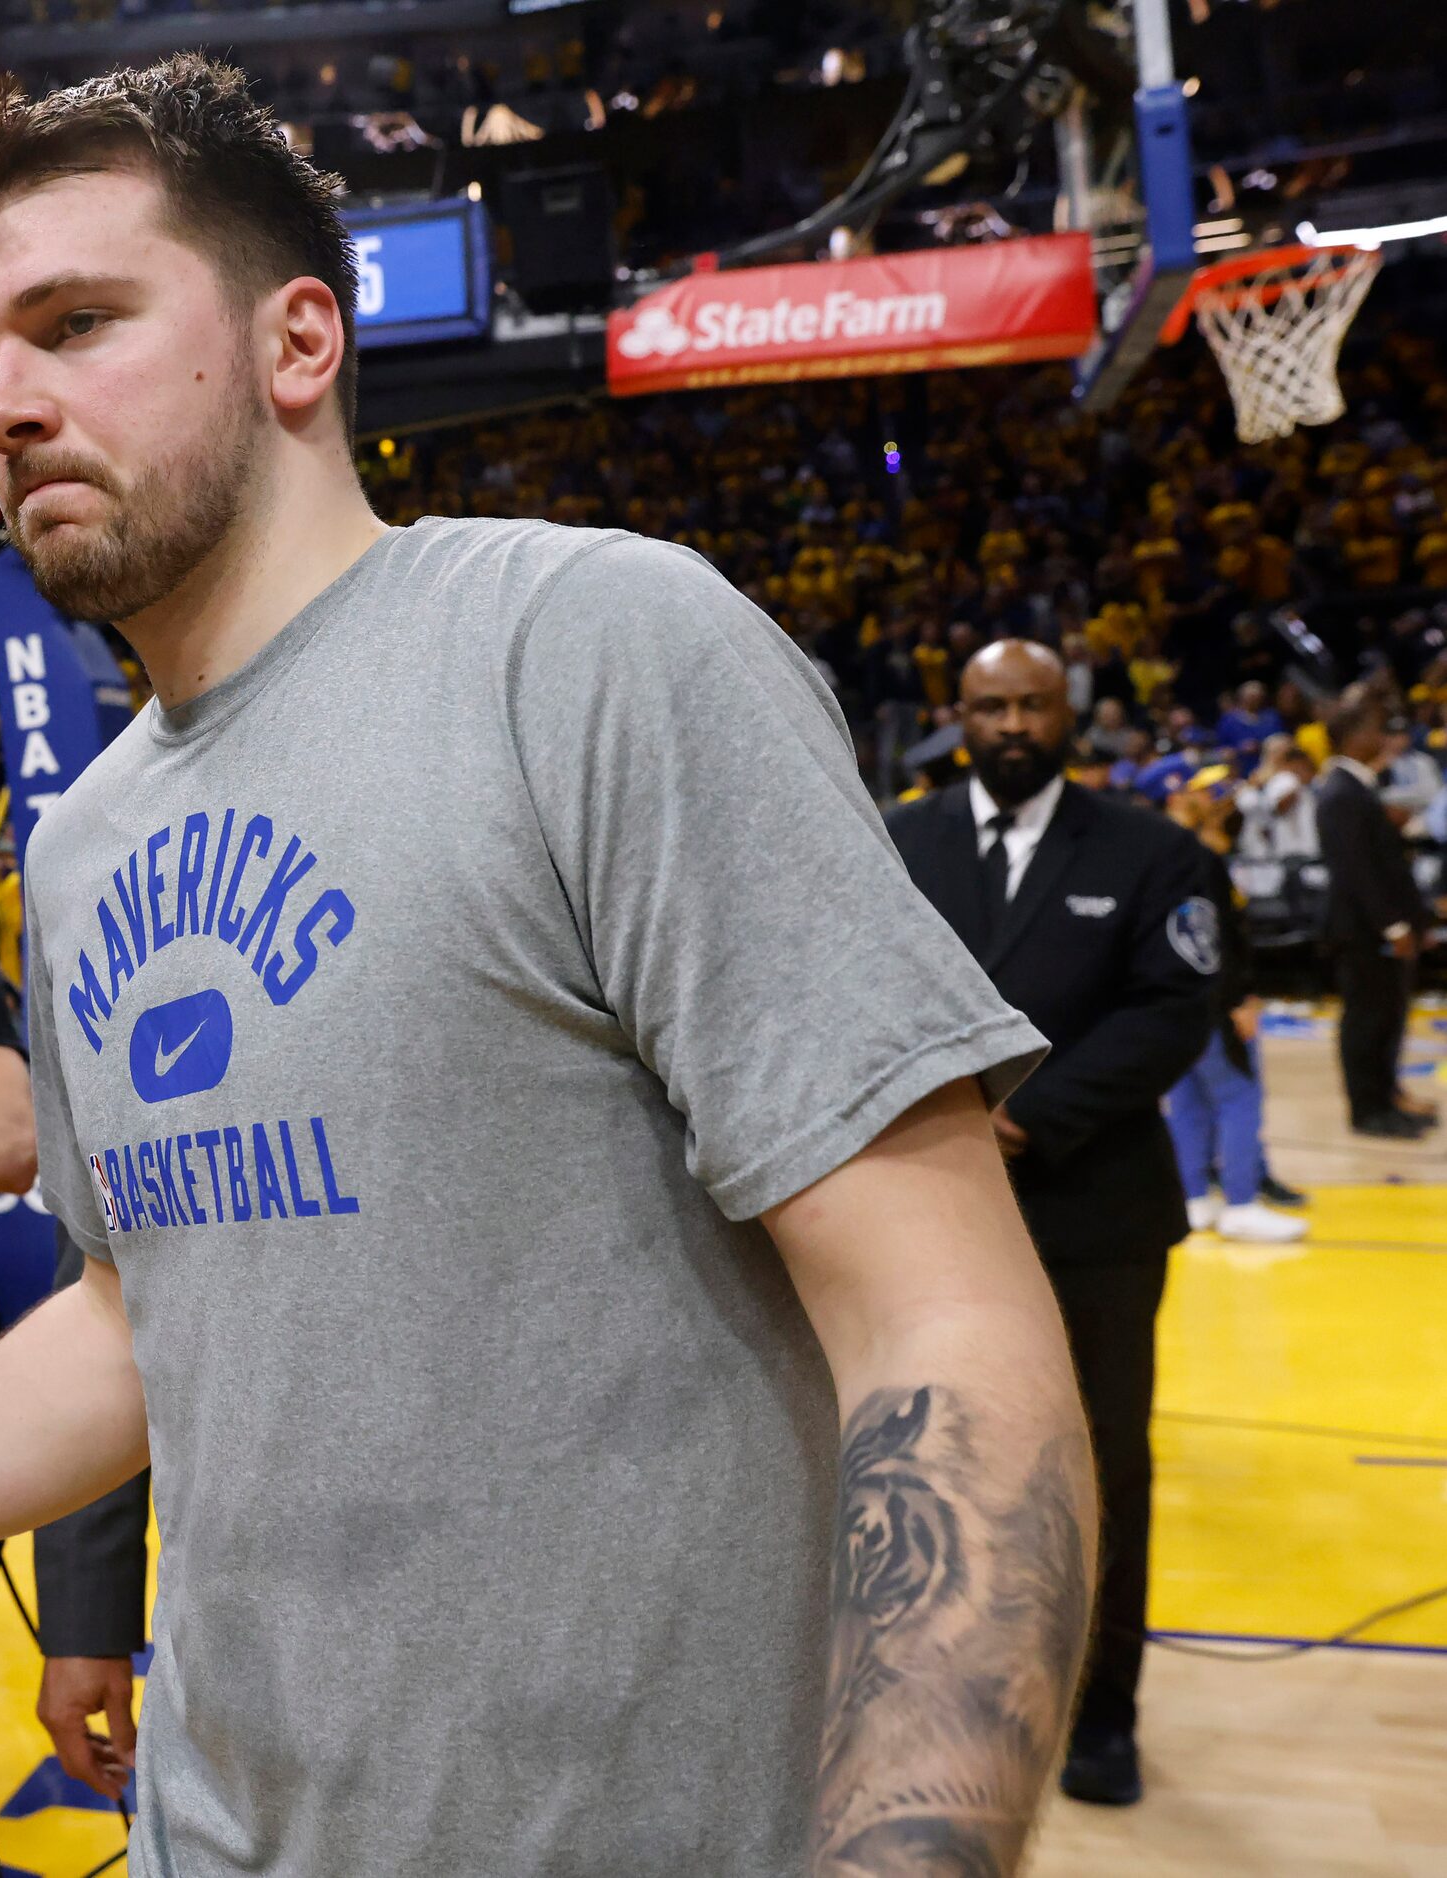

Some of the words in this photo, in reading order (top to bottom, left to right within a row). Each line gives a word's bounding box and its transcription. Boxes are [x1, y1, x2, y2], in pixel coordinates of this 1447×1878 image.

[4, 632, 60, 779] NBA
[69, 809, 355, 1054] MAVERICKS
[105, 1118, 360, 1232] BASKETBALL
